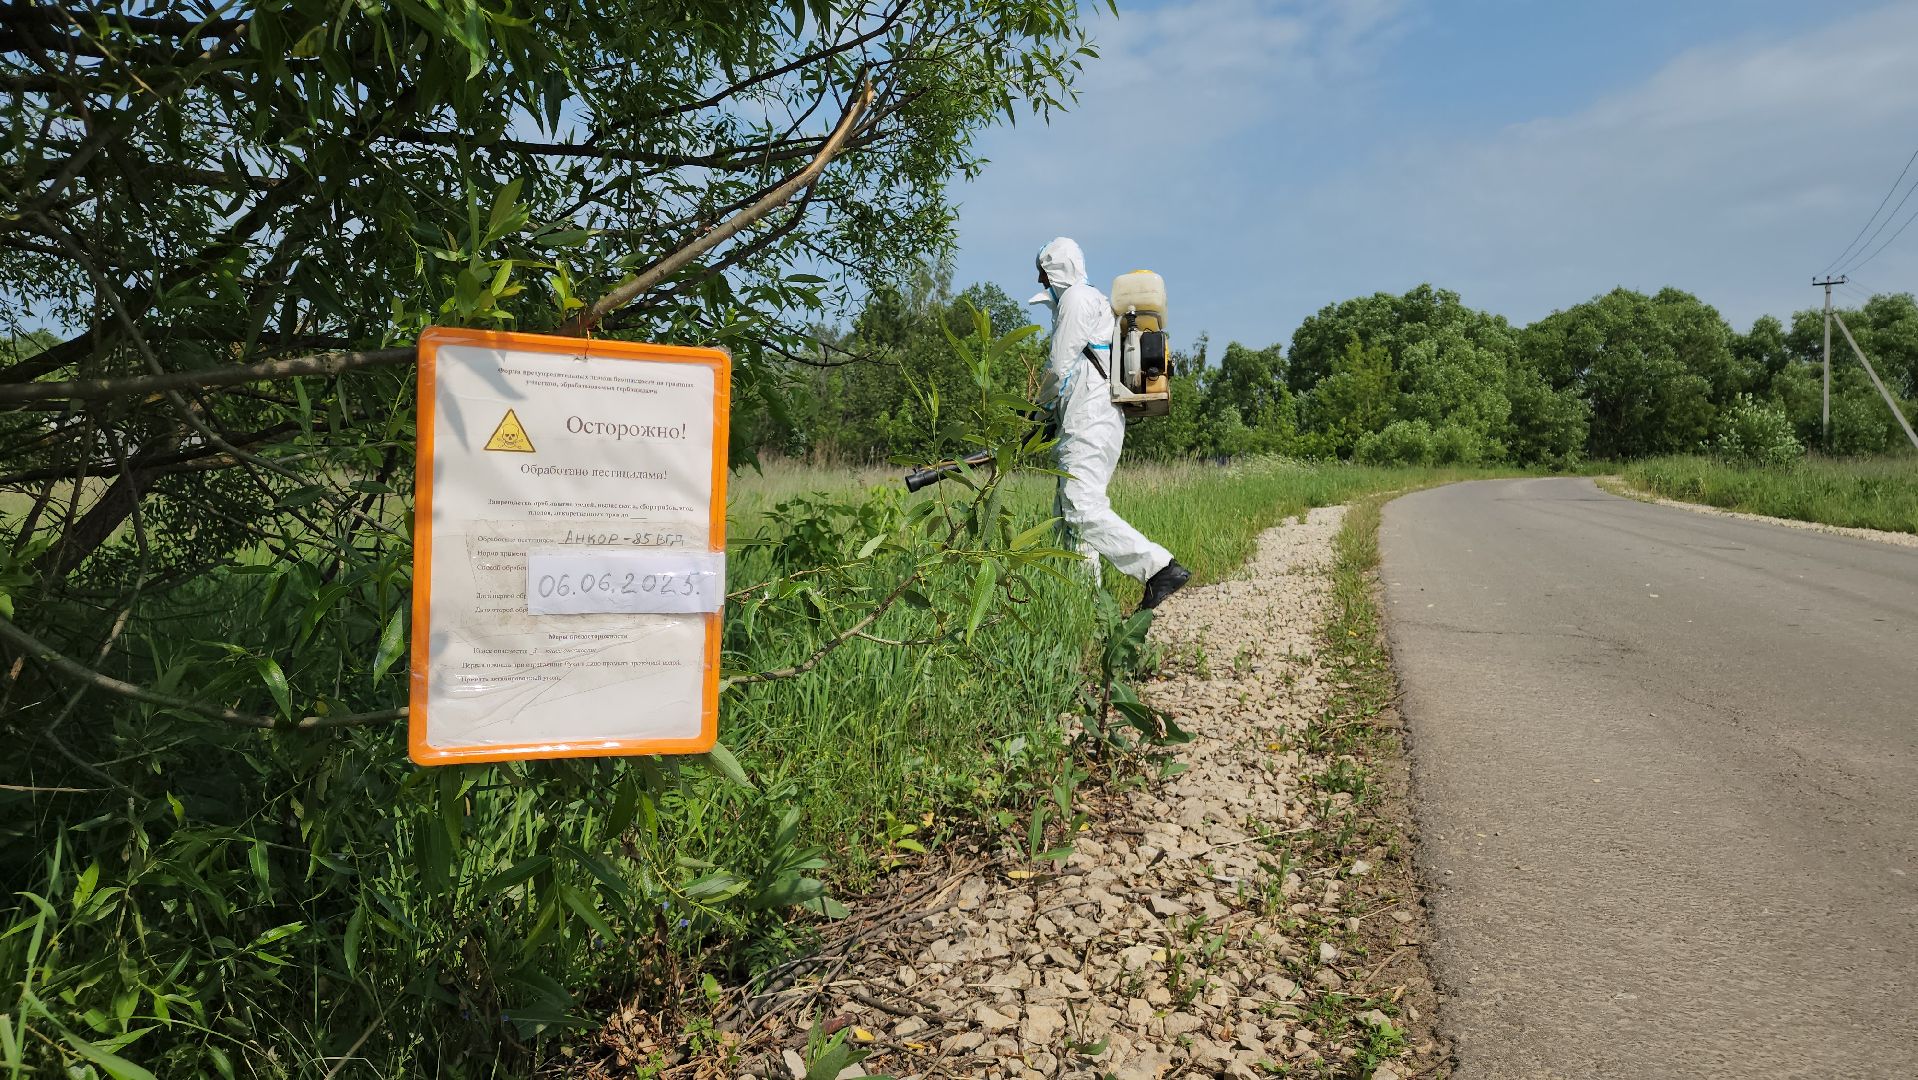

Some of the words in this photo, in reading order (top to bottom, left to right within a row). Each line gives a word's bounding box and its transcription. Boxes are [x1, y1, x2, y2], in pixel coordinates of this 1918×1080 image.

[566, 415, 687, 441] Осторожно!
[520, 463, 589, 477] Обработано
[592, 468, 668, 480] пестицидами!
